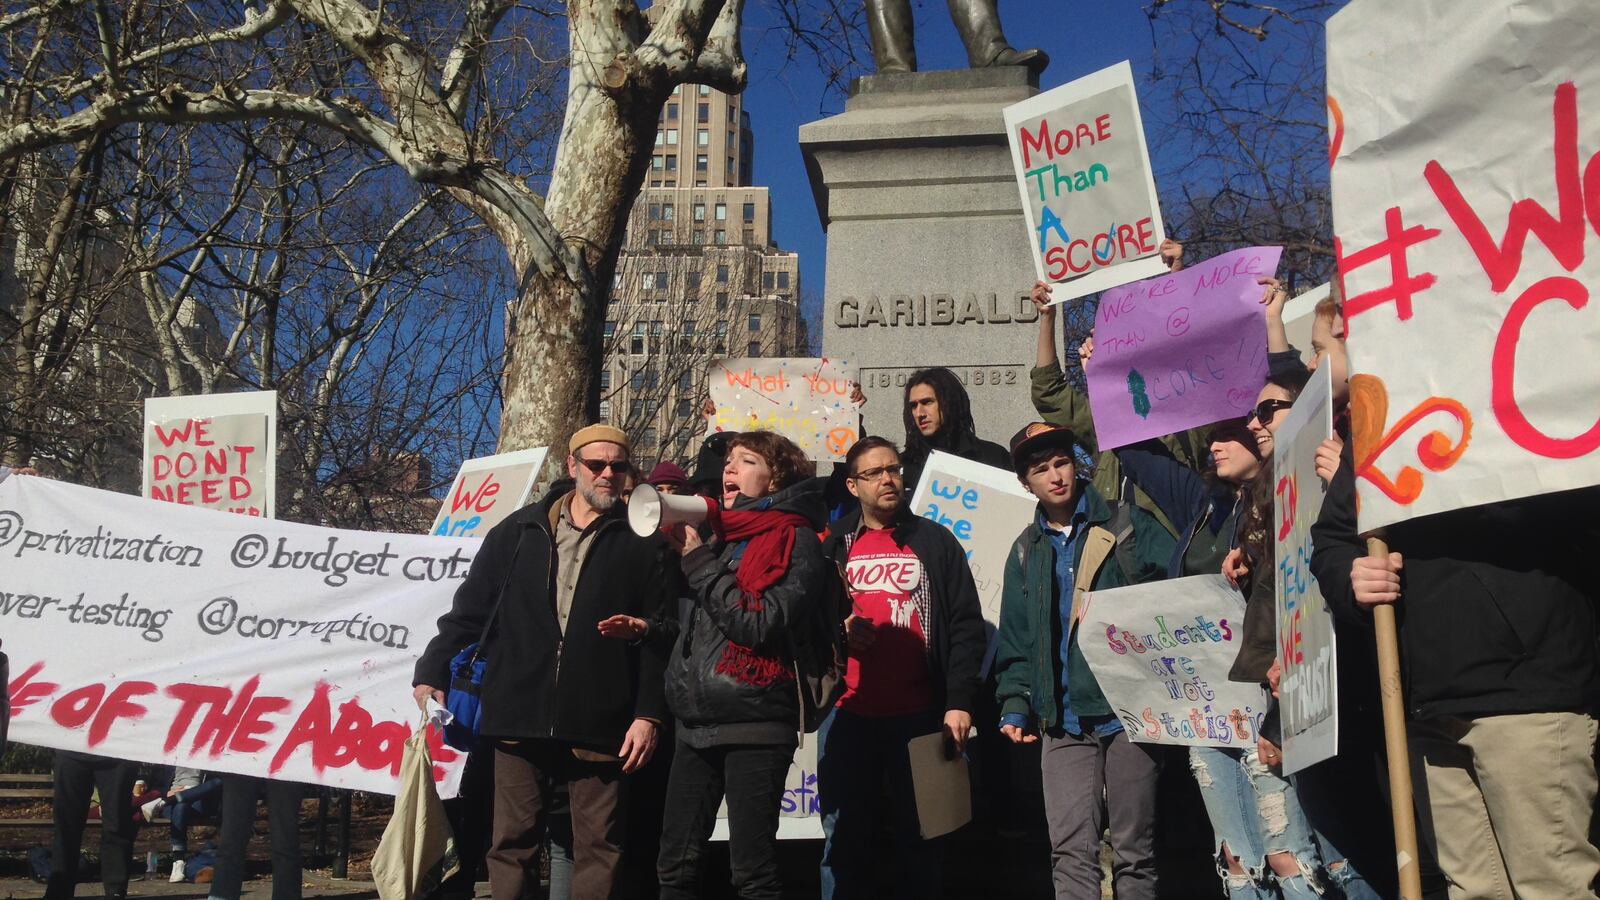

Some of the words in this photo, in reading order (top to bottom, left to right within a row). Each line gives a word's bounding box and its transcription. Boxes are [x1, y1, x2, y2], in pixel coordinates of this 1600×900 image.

[1020, 114, 1111, 168] MORE
[1026, 163, 1108, 201] Than
[1036, 206, 1070, 252] A
[1046, 218, 1155, 280] SCORE
[1102, 280, 1178, 322] WE'RE
[1193, 256, 1263, 296] MORE
[834, 291, 1040, 328] GARIBALD
[725, 368, 790, 392] What
[868, 372, 907, 388] 180
[154, 418, 215, 447] WE
[153, 445, 255, 480] DON'T
[151, 476, 252, 504] NEED
[451, 473, 500, 513] We
[931, 479, 978, 510] we
[1276, 470, 1297, 542] IN
[922, 503, 972, 540] are
[403, 548, 468, 582] cut
[847, 563, 915, 588] MORE
[0, 592, 173, 642] ver-testing
[1280, 608, 1304, 674] WE
[1150, 656, 1195, 677] are
[1165, 676, 1215, 701] Not
[1283, 645, 1330, 735] TRUST
[50, 681, 158, 748] OF
[164, 673, 292, 759] THE
